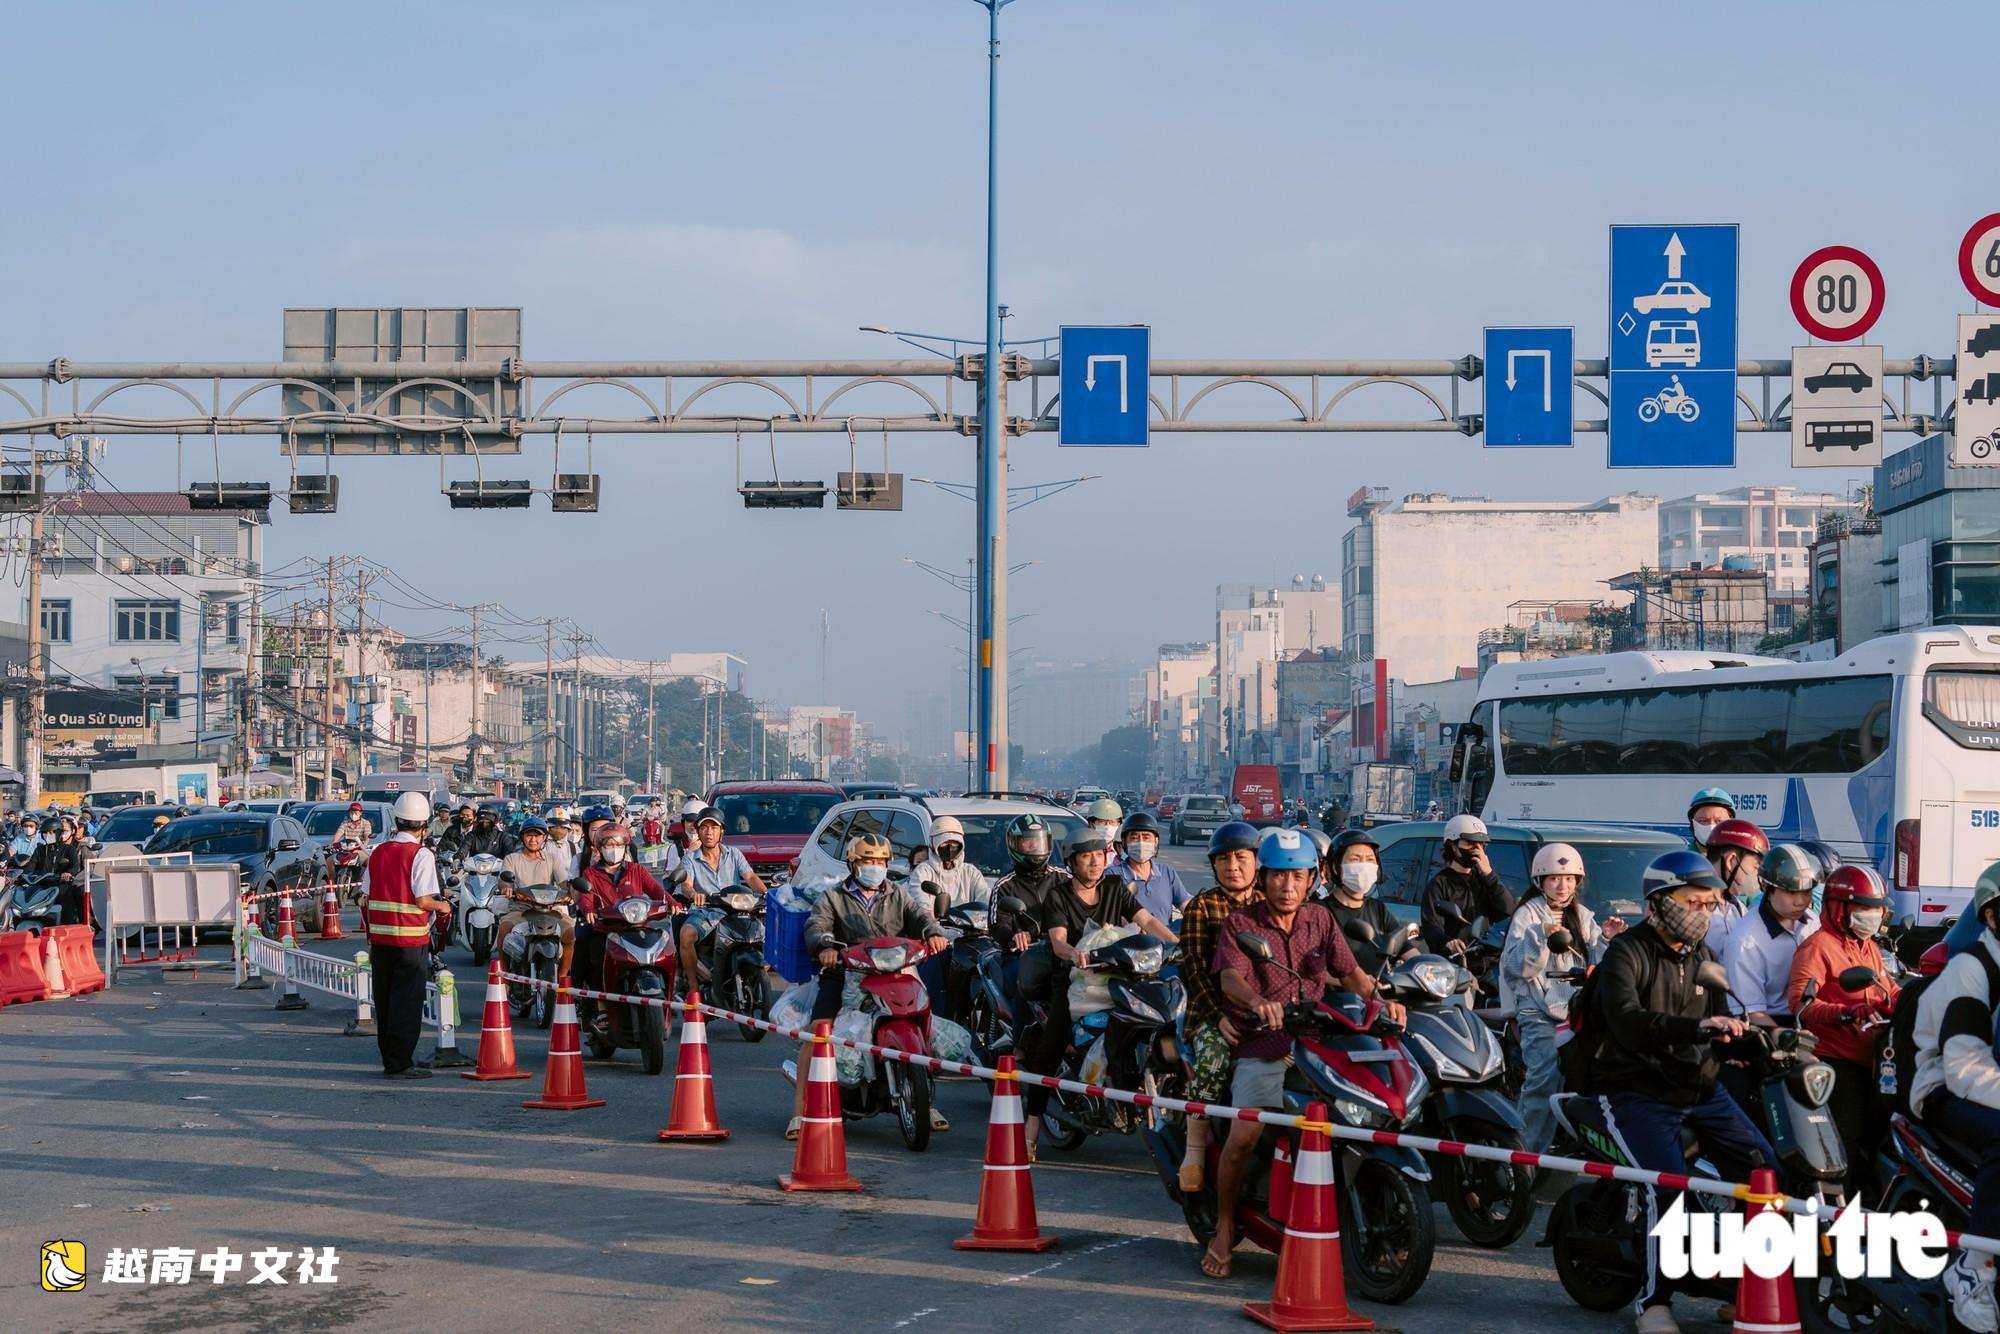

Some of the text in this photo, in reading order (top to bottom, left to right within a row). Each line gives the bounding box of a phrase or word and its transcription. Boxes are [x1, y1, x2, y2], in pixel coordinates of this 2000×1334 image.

[1817, 275, 1857, 314] 80
[60, 713, 86, 727] Qua
[88, 712, 106, 725] Sử
[109, 713, 144, 727] Dụng
[1242, 784, 1262, 793] J&T
